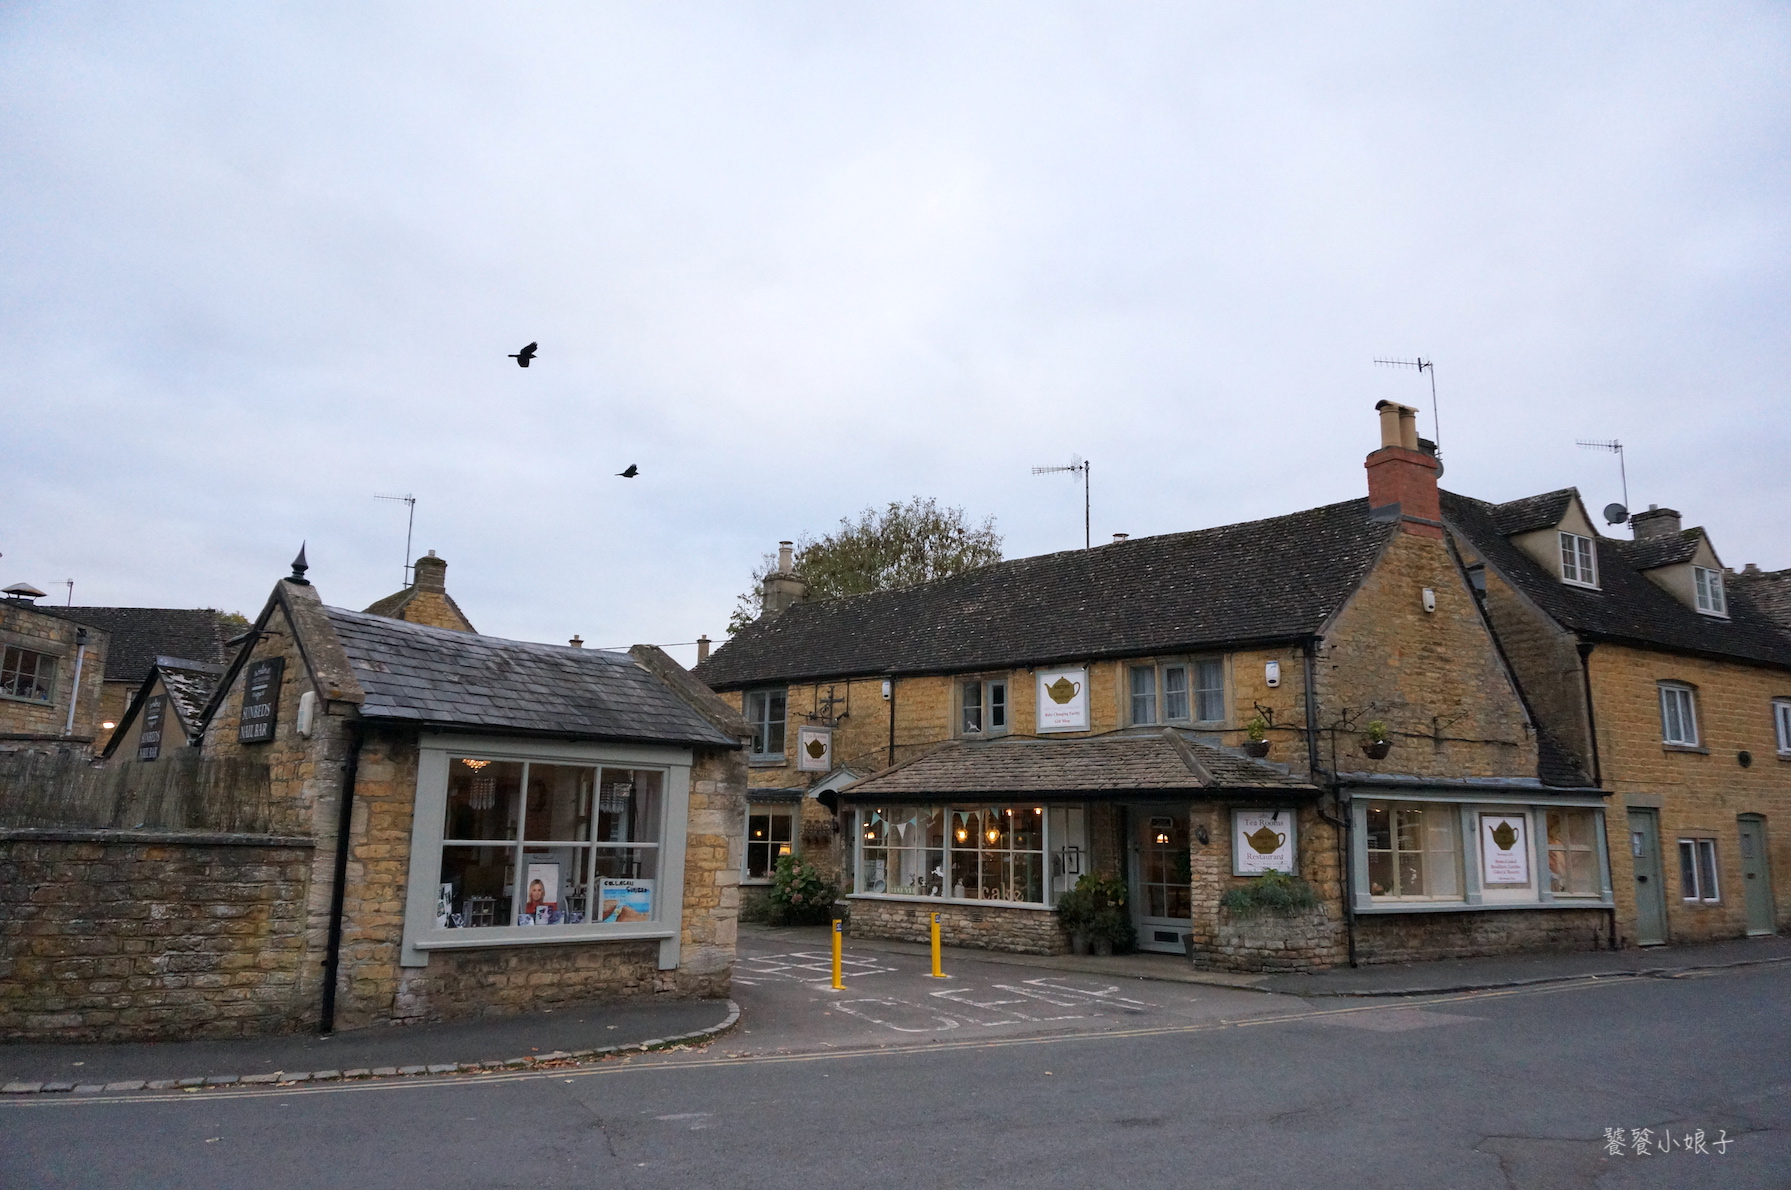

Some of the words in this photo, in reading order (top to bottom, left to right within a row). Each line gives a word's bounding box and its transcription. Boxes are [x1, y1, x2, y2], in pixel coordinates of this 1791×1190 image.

[242, 704, 270, 720] SUNBEDS
[141, 731, 160, 743] SUNBEDS
[239, 724, 254, 739] NAIL
[254, 722, 267, 738] BAR
[139, 748, 149, 758] NAIL
[149, 747, 158, 758] BAR
[981, 882, 1025, 902] cake
[827, 977, 1158, 1033] CLEAR
